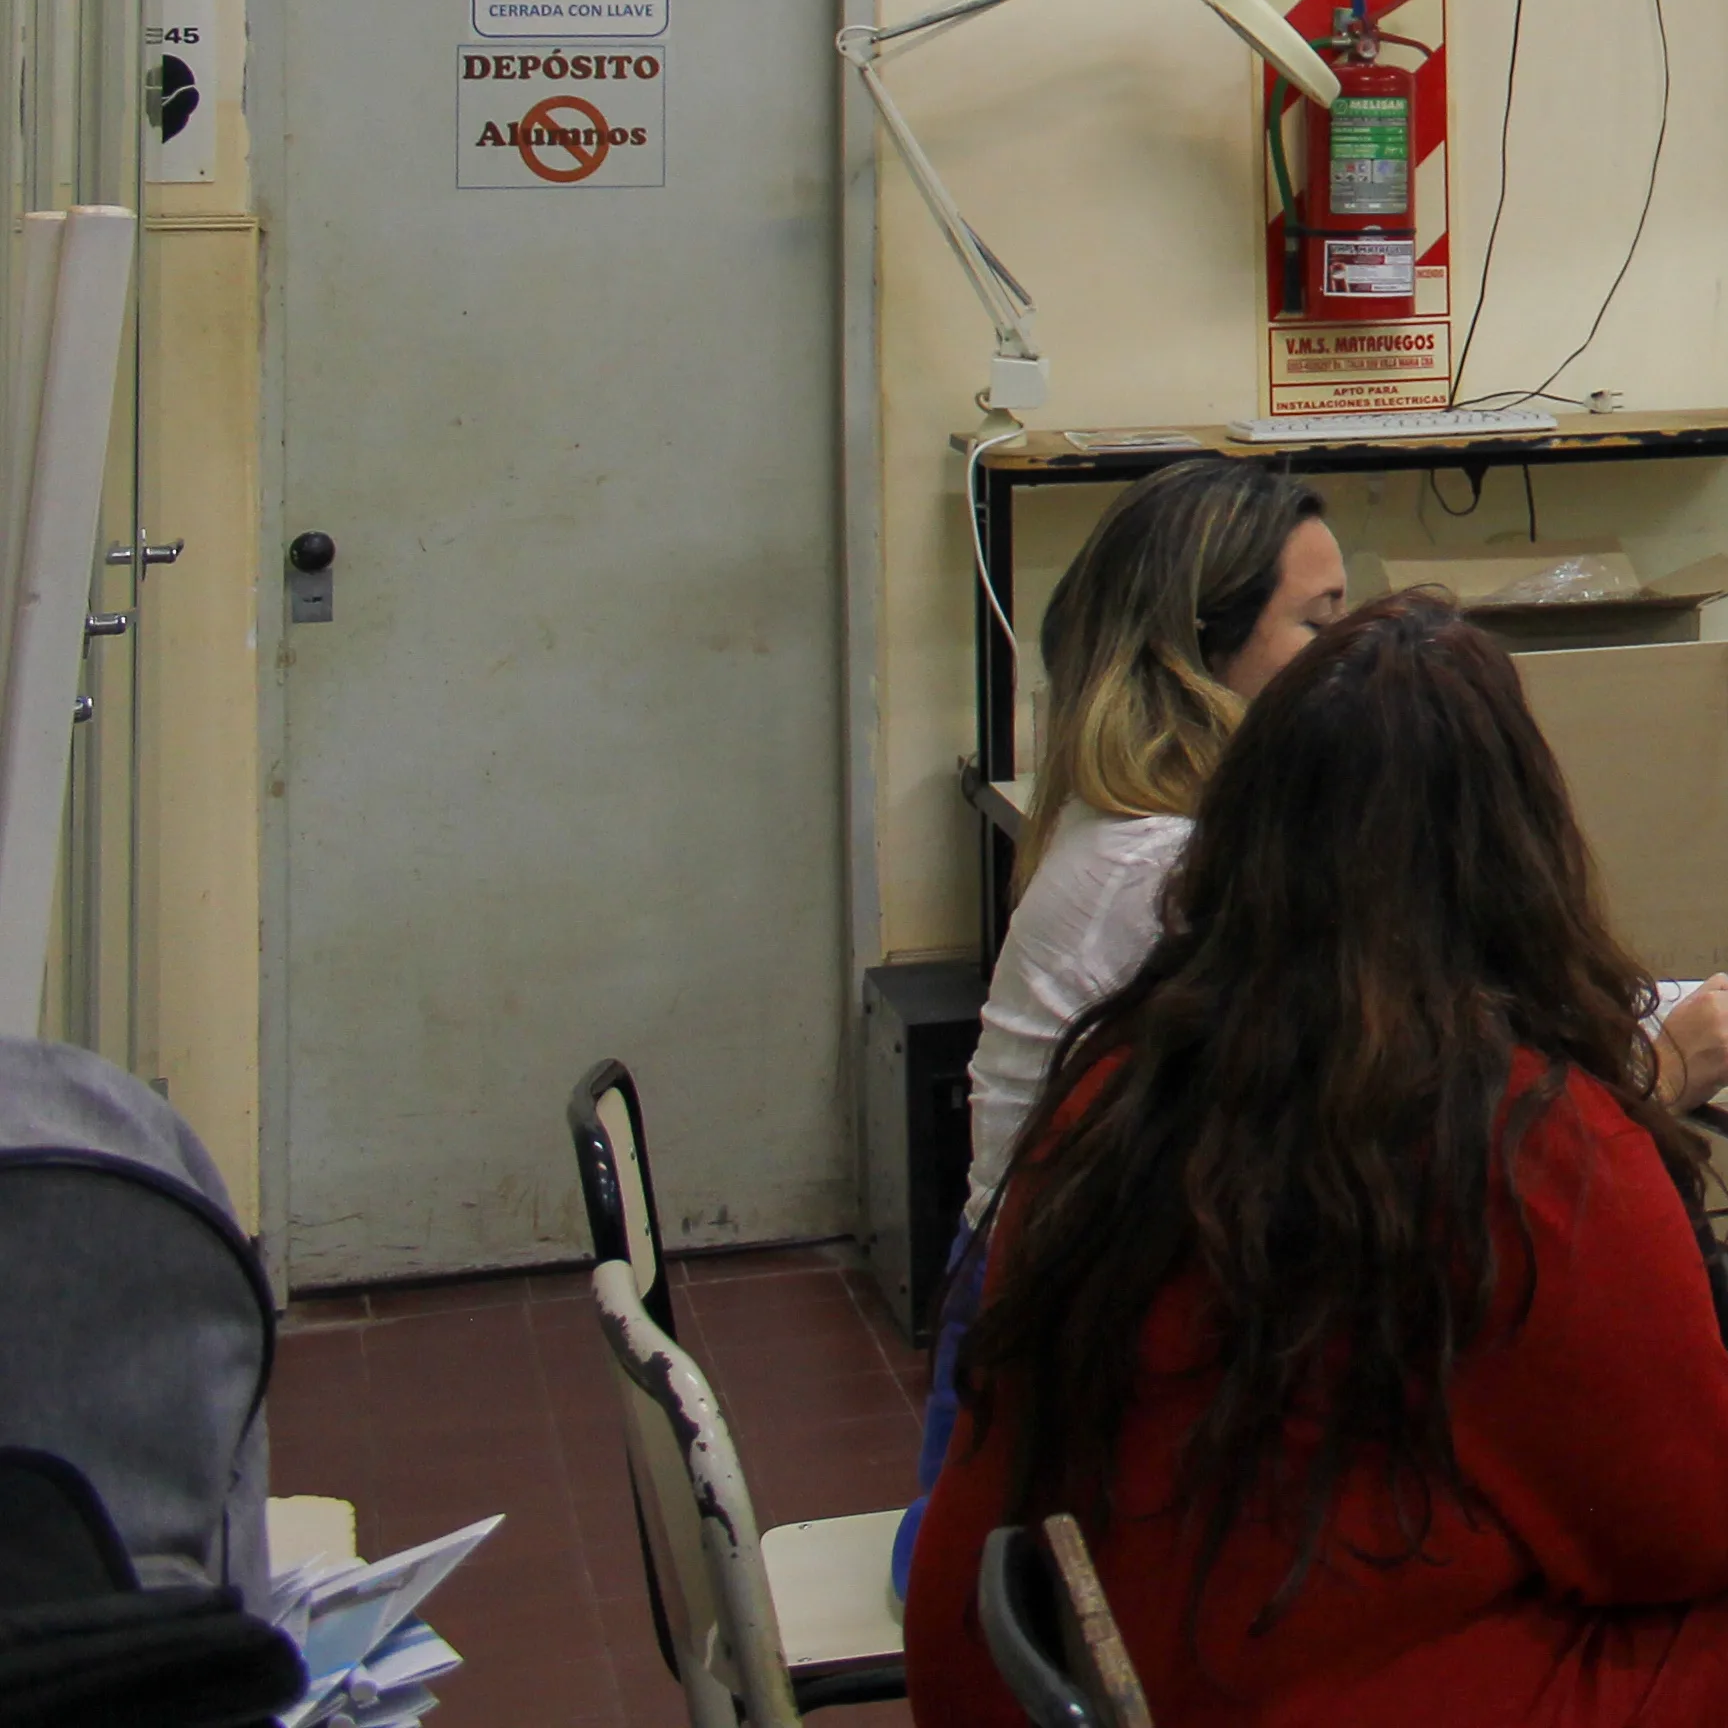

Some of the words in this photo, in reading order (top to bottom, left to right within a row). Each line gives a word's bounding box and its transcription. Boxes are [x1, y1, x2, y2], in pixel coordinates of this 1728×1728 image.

[489, 4, 564, 17] CERRADA
[568, 4, 601, 17] CON
[607, 4, 653, 17] LLAVE
[462, 48, 660, 80] DEPÓSITO
[475, 121, 647, 147] Alumnos
[1286, 338, 1329, 355] V.M.S.
[1335, 333, 1435, 353] MATAFUEGOS
[1333, 386, 1364, 396] APTO
[1368, 385, 1399, 395] PARA
[1276, 398, 1371, 411] INSTALACIONES
[1374, 395, 1447, 407] ELECTRICAS
